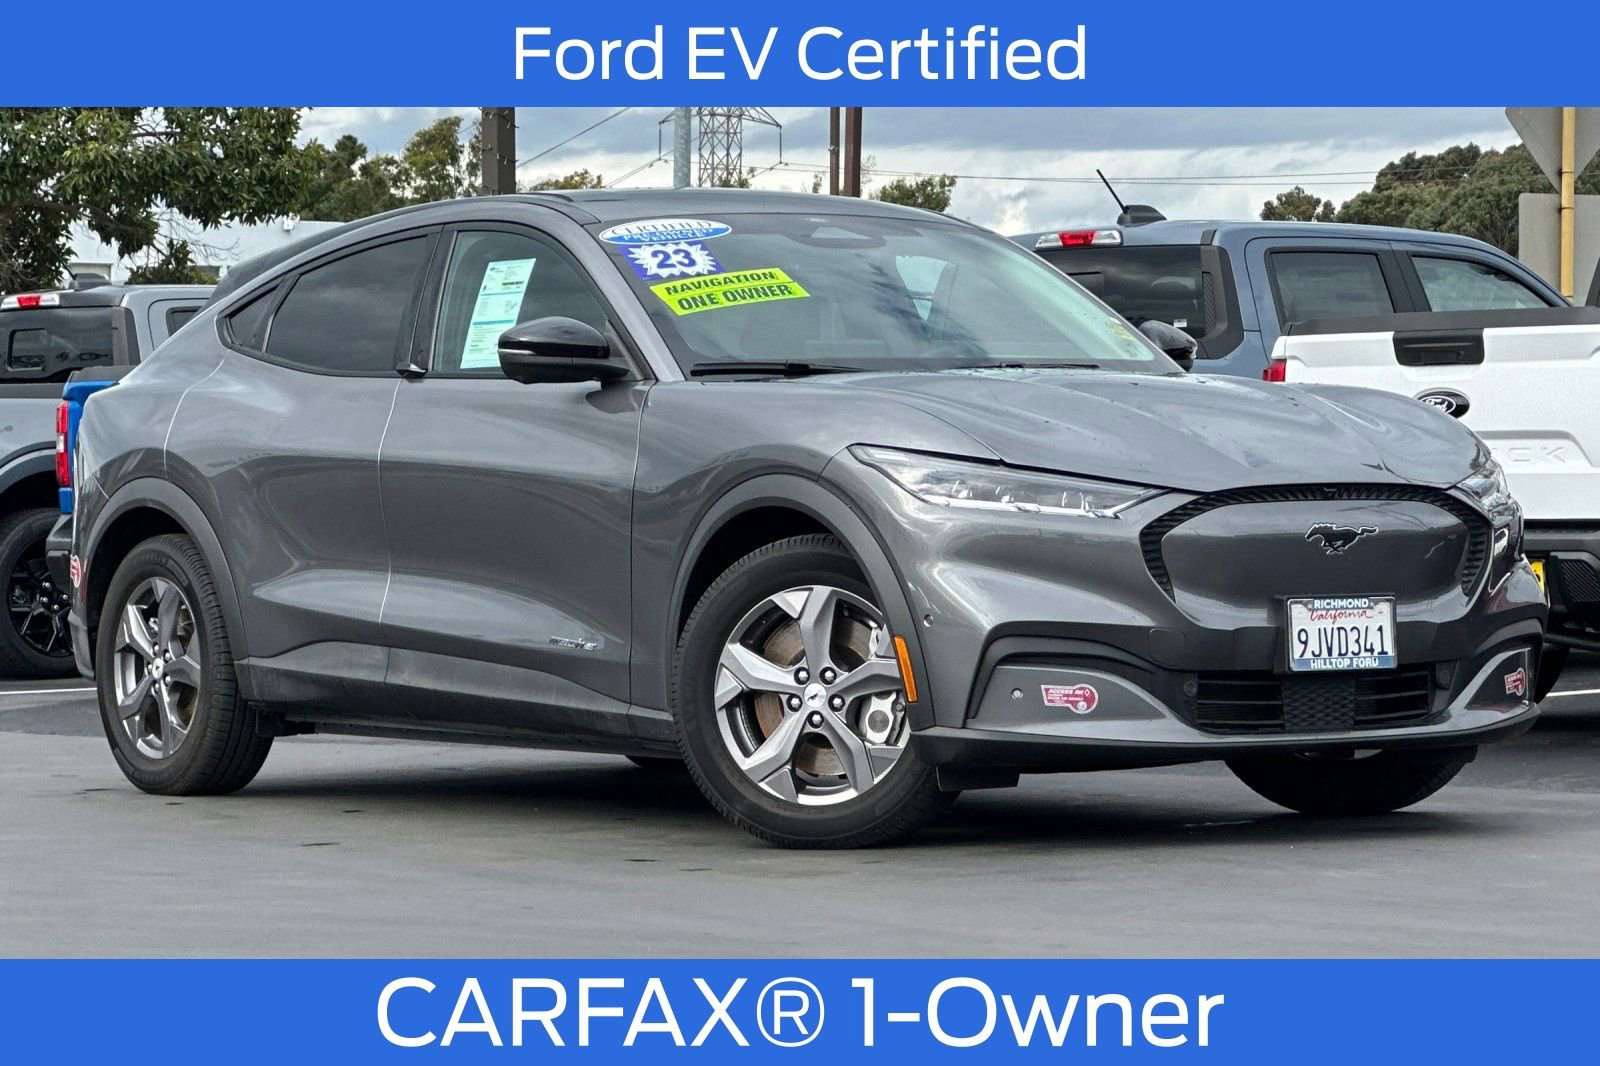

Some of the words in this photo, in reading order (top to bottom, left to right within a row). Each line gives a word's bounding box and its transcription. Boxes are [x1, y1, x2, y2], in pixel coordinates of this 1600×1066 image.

[651, 248, 697, 270] 23
[664, 271, 776, 296] NAVIGATION
[677, 293, 719, 311] ONE
[722, 284, 794, 303] OWNER
[1314, 598, 1369, 609] RICHMOND
[1310, 610, 1373, 625] California
[1297, 625, 1389, 658] 9JVD341
[1310, 658, 1351, 669] HILLTOP
[1353, 657, 1379, 668] FORD
